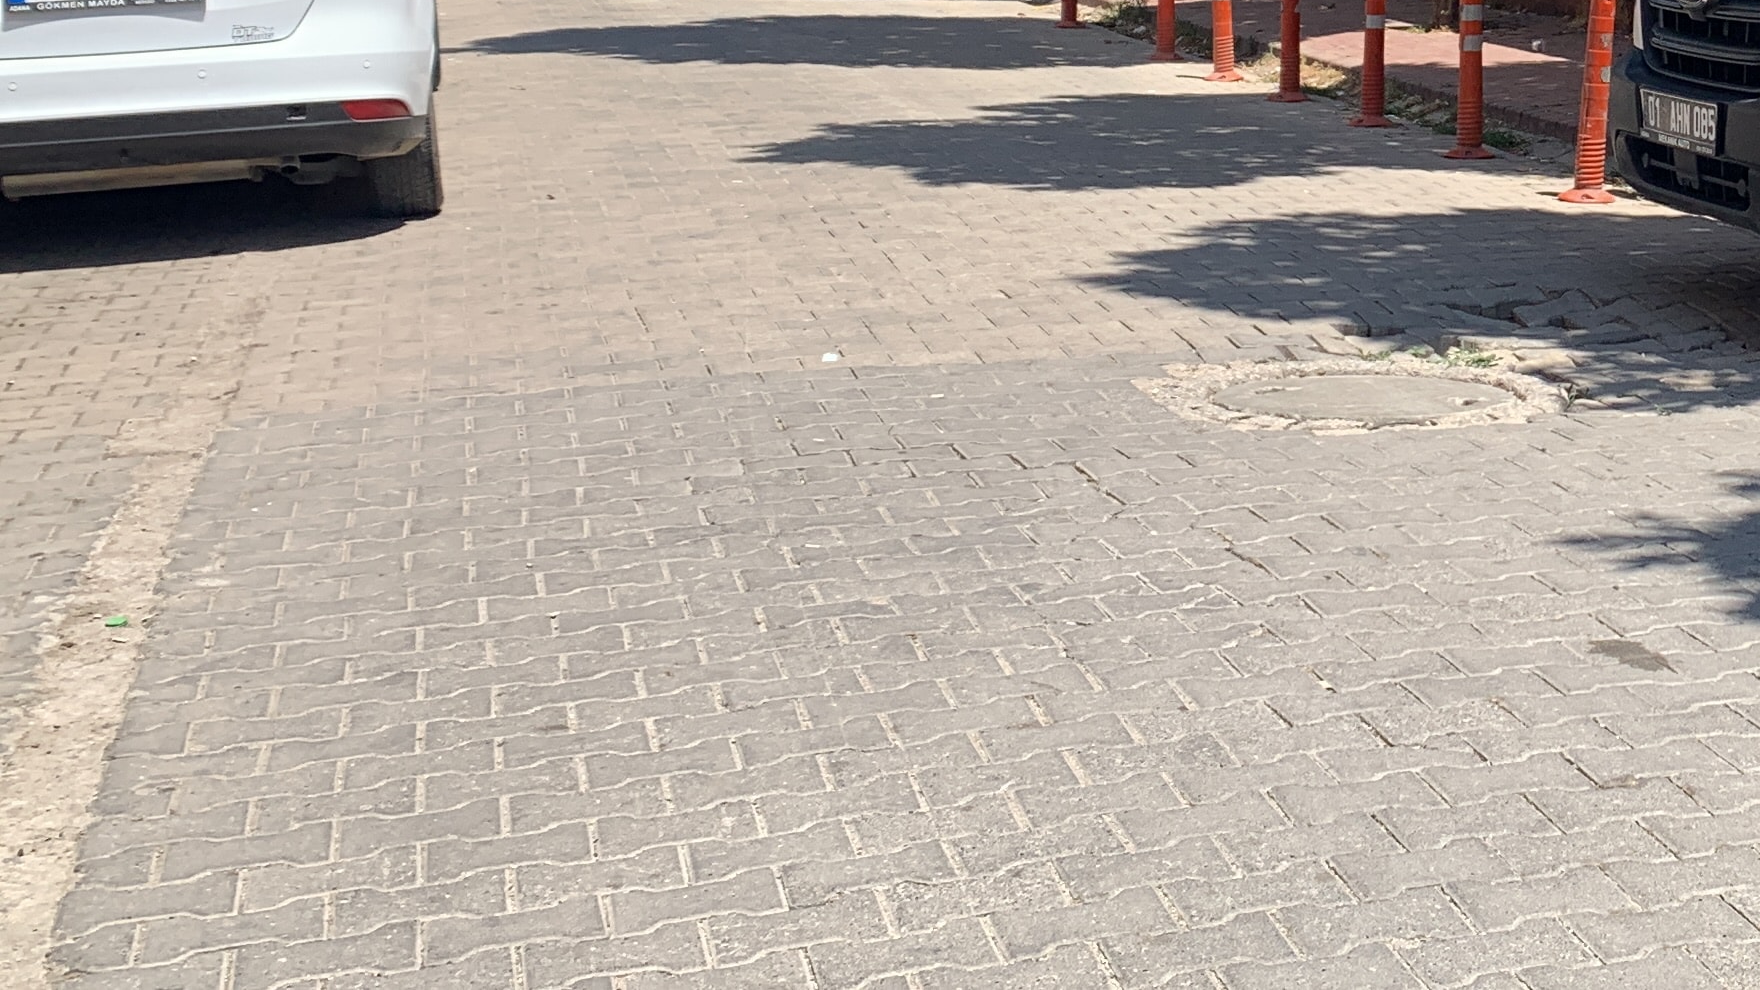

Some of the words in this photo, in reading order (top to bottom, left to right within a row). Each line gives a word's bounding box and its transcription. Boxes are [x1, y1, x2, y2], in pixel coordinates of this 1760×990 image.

[36, 0, 85, 11] GÖKMEN
[87, 0, 125, 8] MAYDA
[1648, 96, 1661, 128] 01
[1670, 101, 1691, 136] AHN
[1693, 105, 1716, 142] 085
